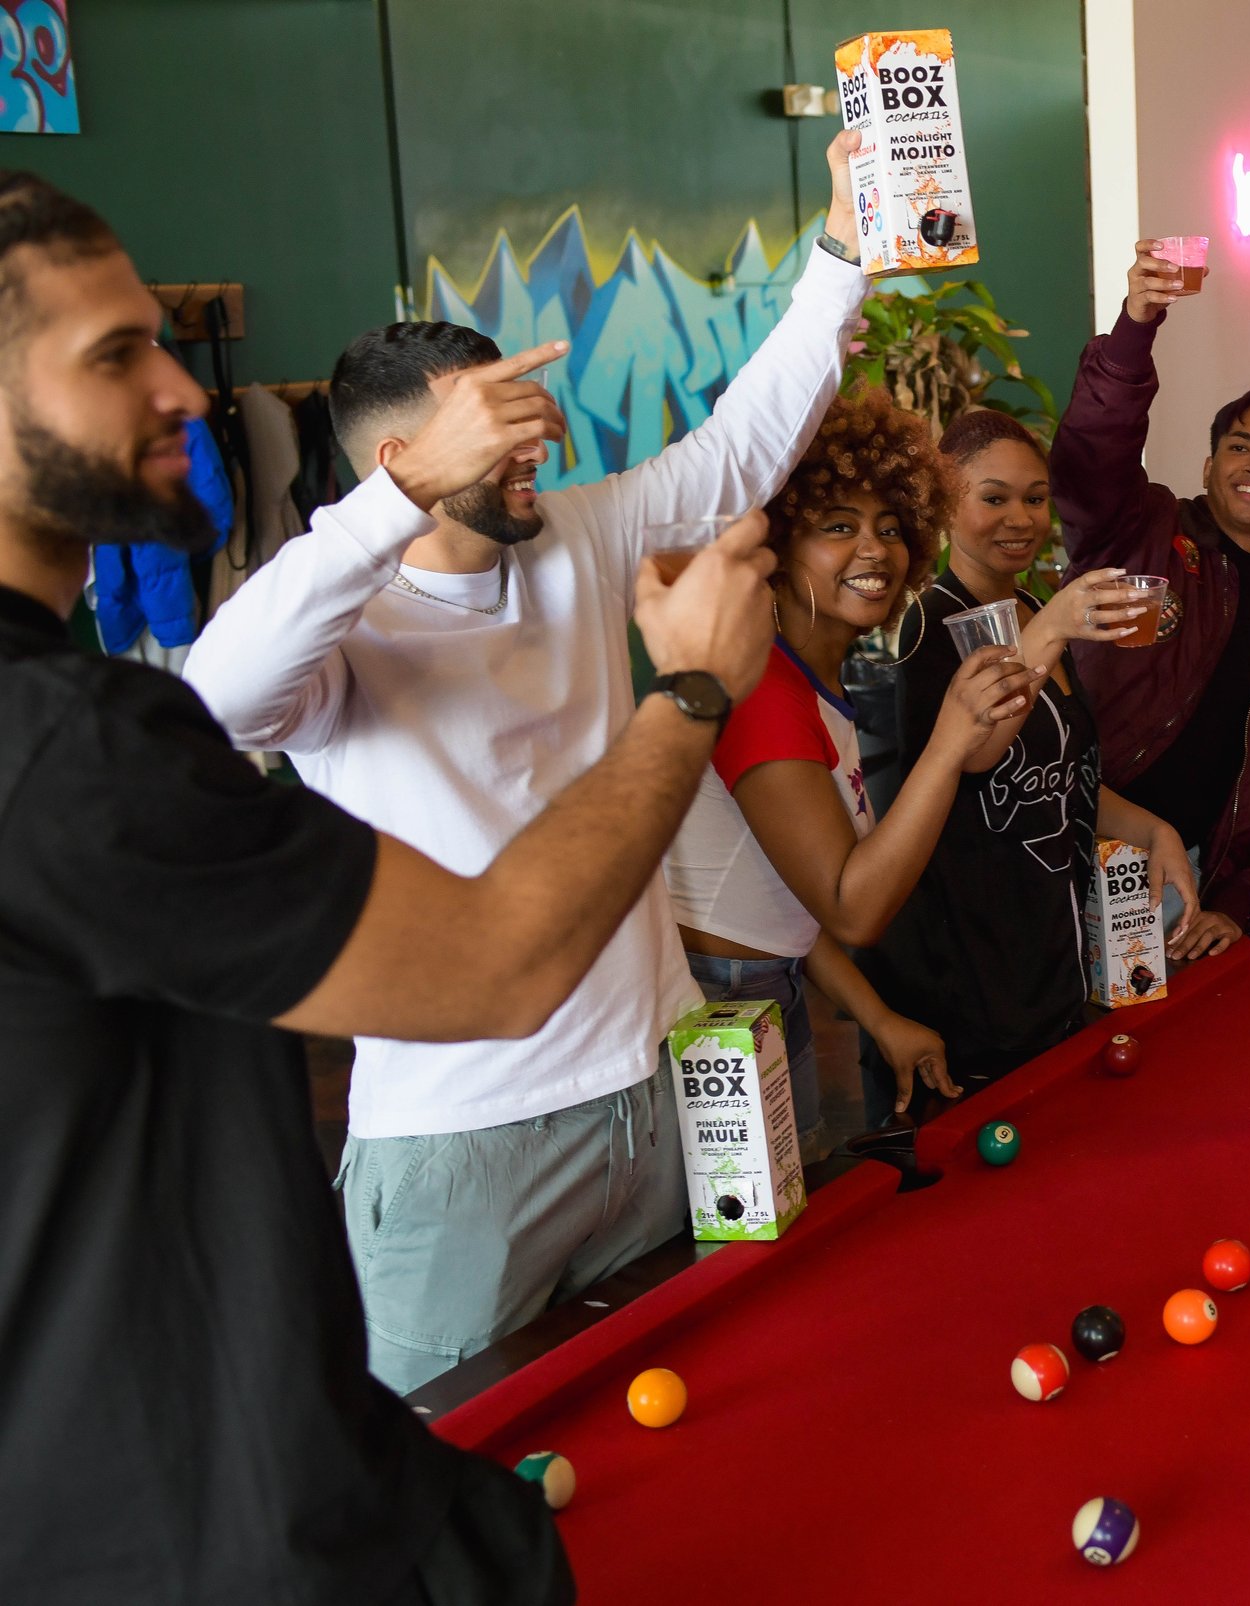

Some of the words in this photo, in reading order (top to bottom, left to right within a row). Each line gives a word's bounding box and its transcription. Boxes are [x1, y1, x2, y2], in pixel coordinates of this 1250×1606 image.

[878, 65, 944, 85] BOOZ
[842, 72, 866, 98] BOOZ
[881, 85, 948, 110] BOX
[845, 92, 870, 122] BOX
[885, 111, 949, 123] COCKTAILS
[890, 132, 952, 144] MOONLIGHT
[891, 144, 955, 161] MOJITO
[1107, 874, 1150, 896] BOX
[1111, 915, 1156, 932] MOJITO
[681, 1058, 745, 1074] BOOZ
[683, 1076, 748, 1097] BOX
[686, 1099, 750, 1109] COCKTAILS
[696, 1120, 747, 1128] PINEAPPLE
[698, 1129, 749, 1142] MULE
[1208, 1304, 1216, 1316] 5
